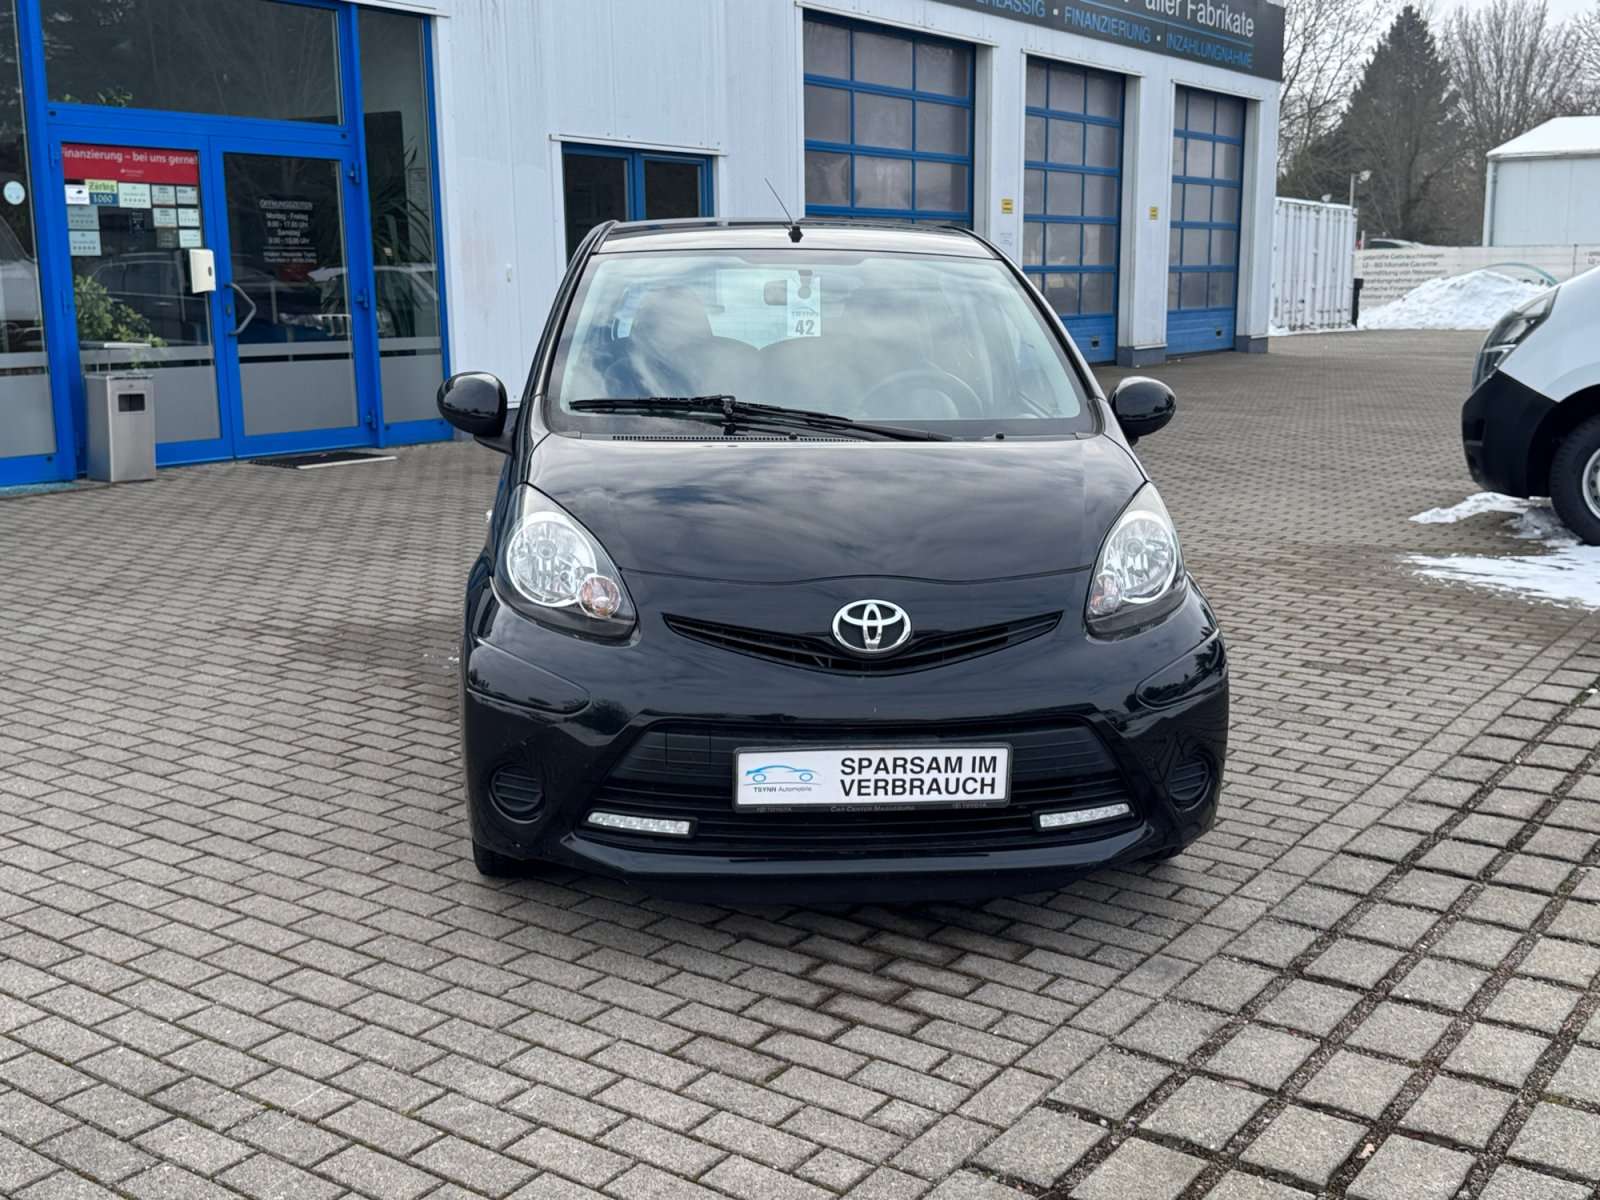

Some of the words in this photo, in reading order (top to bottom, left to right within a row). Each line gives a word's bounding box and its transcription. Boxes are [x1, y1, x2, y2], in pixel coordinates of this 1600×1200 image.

[1187, 0, 1255, 37] Fabrikate
[1064, 6, 1151, 44] FINANZIERUNG
[1166, 31, 1253, 67] INZAHLUNGNAHME
[132, 151, 148, 162] bei
[149, 153, 166, 163] uns
[795, 320, 815, 335] 42
[840, 756, 963, 776] SPARSAM
[971, 756, 997, 774] IM
[840, 777, 996, 797] VERBRAUCH
